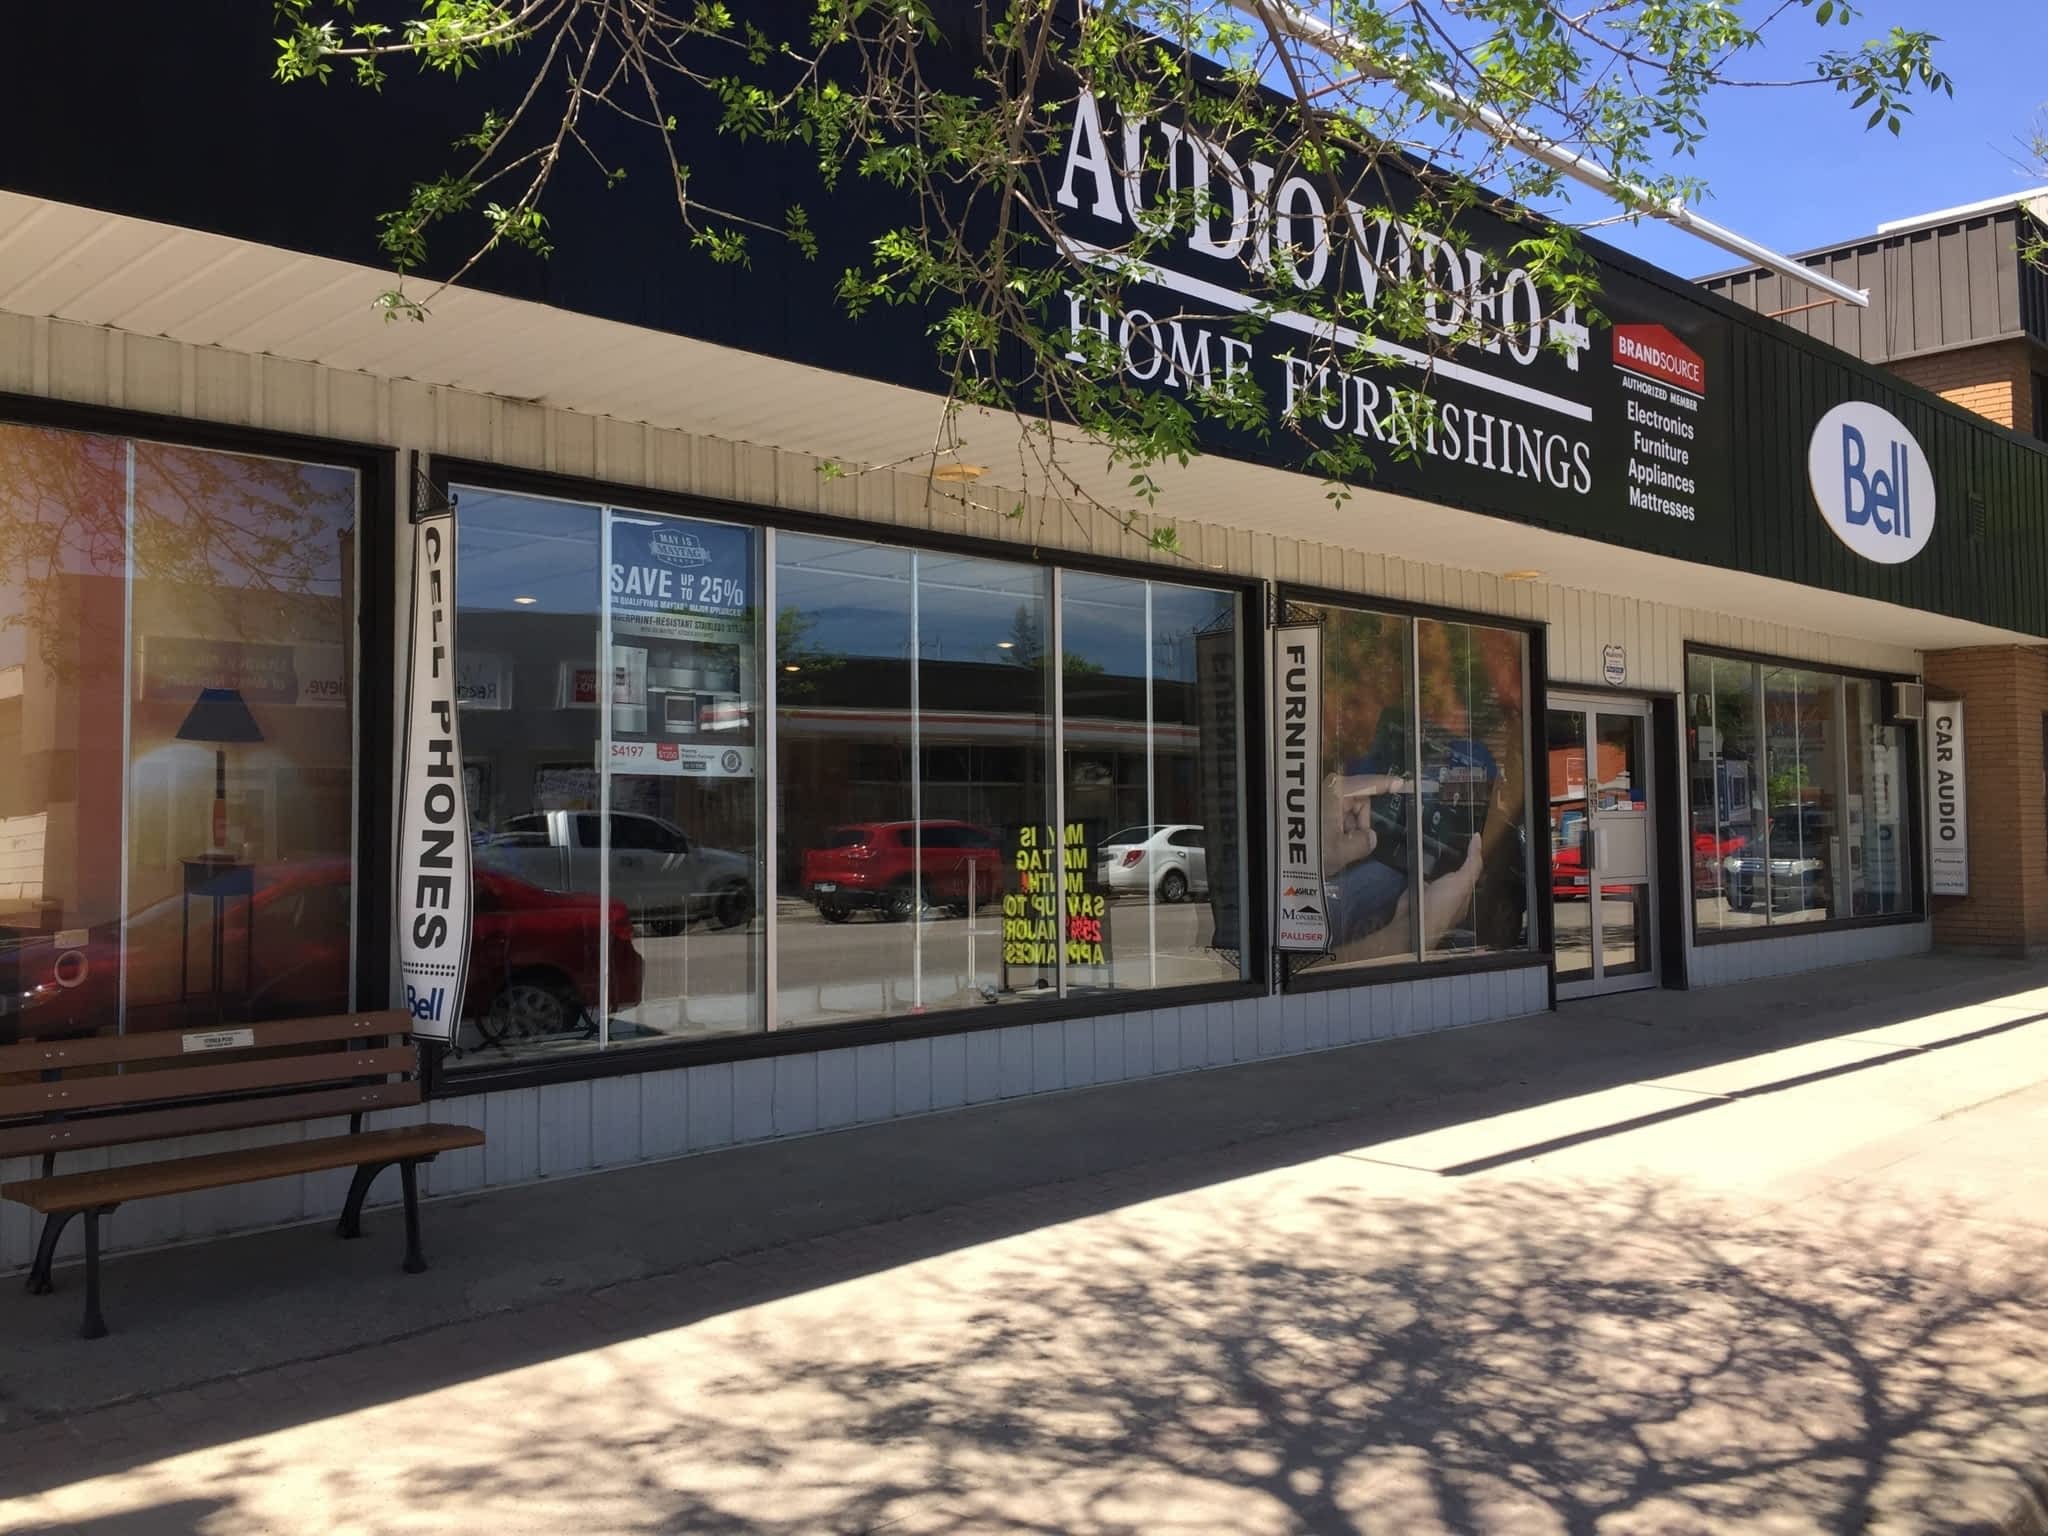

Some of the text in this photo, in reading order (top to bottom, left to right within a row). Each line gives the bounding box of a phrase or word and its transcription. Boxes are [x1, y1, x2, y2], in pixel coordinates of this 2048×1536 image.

[1057, 86, 1329, 291] AUDIO
[1619, 336, 1700, 382] BRANDSOURCE
[1064, 290, 1592, 495] HOME FURNISHINGS
[1622, 376, 1698, 412] AUTHORIZED MEMBER
[1627, 399, 1694, 440] Electronics
[1634, 430, 1689, 465] Furniture
[1628, 457, 1695, 495] Appliances
[1842, 424, 1911, 538] Bell
[1629, 485, 1695, 521] Mattresses
[611, 563, 744, 606] SAVE UP TO 25%
[412, 526, 456, 950] CELL PHONES
[611, 745, 644, 757] $4197
[1285, 645, 1307, 864] FURNITURE
[1935, 715, 1953, 763] CAR
[1937, 769, 1956, 842] AUDIO
[1280, 931, 1323, 941] PALLISER
[407, 984, 444, 1021] Bell
